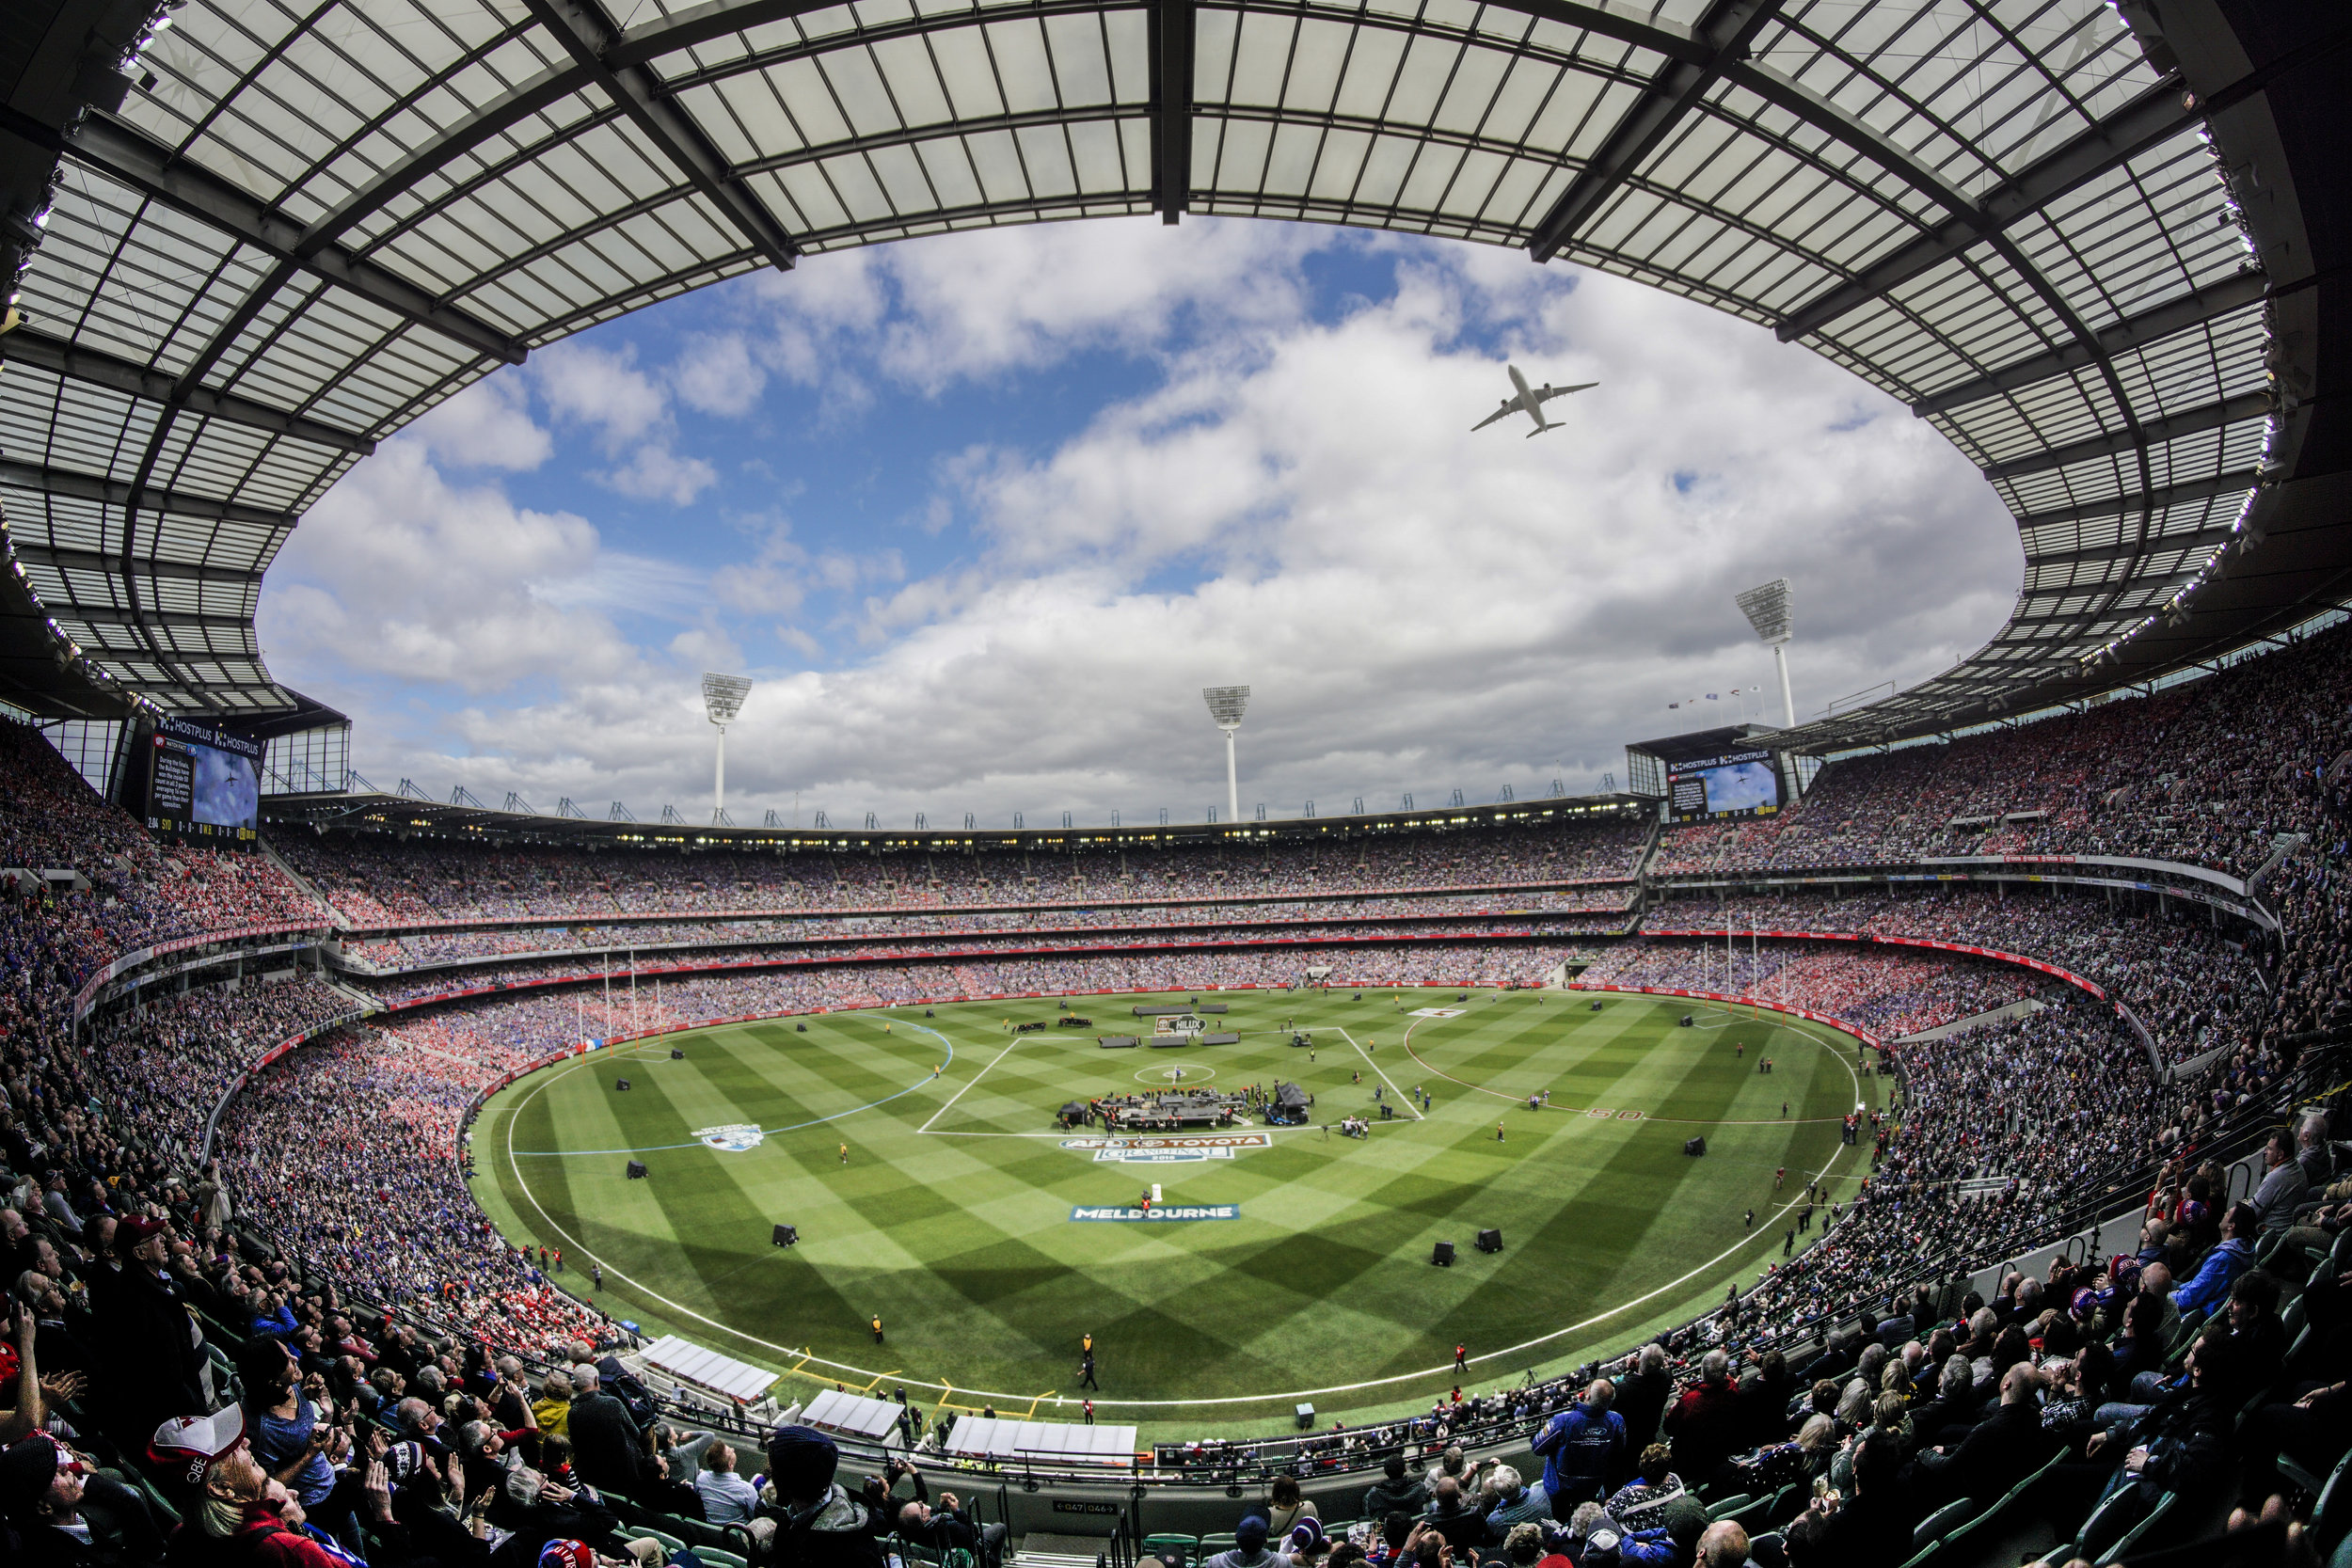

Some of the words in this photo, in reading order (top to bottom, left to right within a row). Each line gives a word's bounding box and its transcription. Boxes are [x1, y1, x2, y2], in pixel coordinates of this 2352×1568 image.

[175, 720, 212, 741] HOSTPLUS
[227, 736, 259, 755] HOSTPLUS
[1732, 750, 1769, 762] HOSTPLUS
[1683, 758, 1717, 769] HOSTPLUS
[1176, 1020, 1200, 1030] HILUX
[1067, 1139, 1123, 1148] AFL
[1168, 1137, 1262, 1147] TOYOTA
[1105, 1149, 1167, 1157] GRAND
[1168, 1148, 1217, 1156] FINAL
[1075, 1207, 1233, 1219] MELBOURNE
[187, 1457, 207, 1483] QBE
